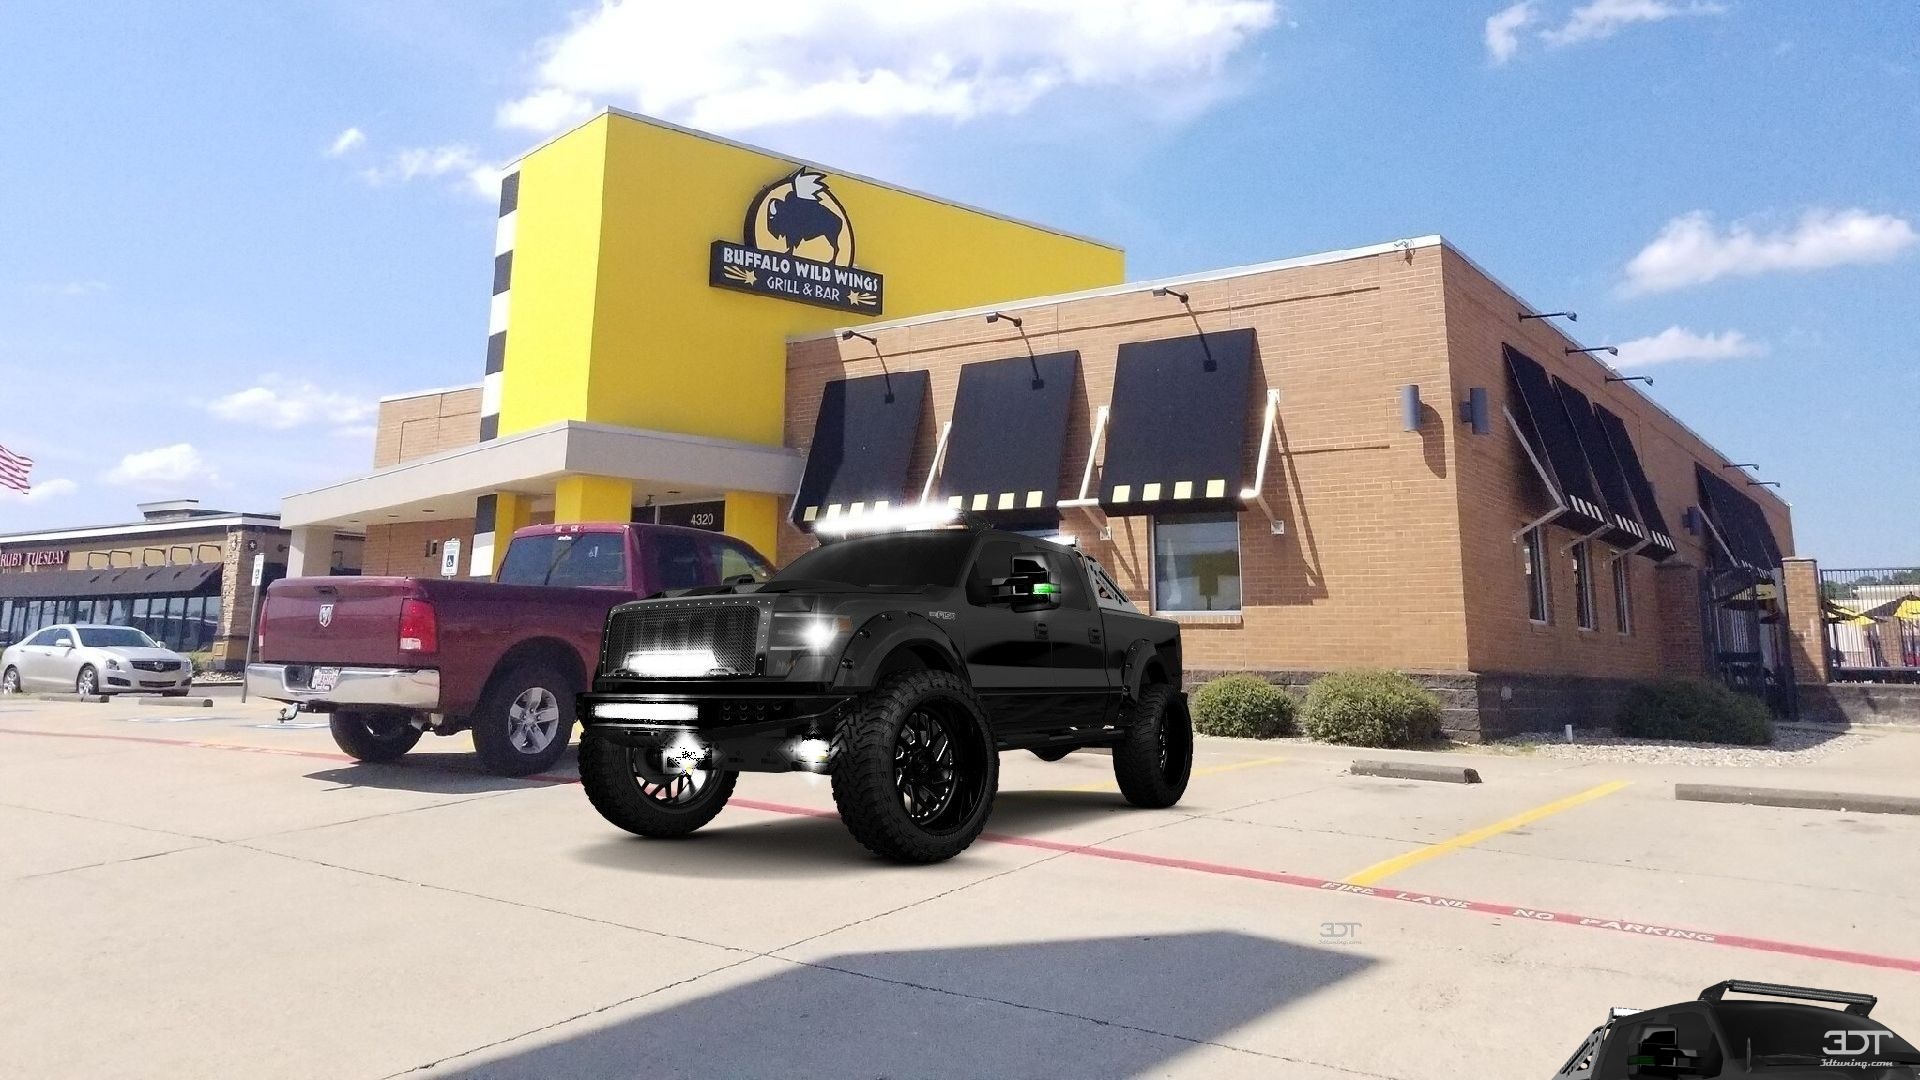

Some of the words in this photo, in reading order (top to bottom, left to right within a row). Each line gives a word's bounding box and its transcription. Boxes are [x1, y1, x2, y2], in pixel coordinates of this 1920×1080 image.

[723, 247, 790, 274] BUFFALO
[795, 261, 831, 282] WILD
[835, 269, 878, 292] WINGS
[767, 276, 800, 295] GRILL
[802, 283, 813, 297] &
[815, 285, 840, 301] BAR
[691, 513, 714, 526] 4320
[0, 553, 22, 567] RUBY
[26, 550, 66, 566] TUESDAY
[1320, 882, 1376, 896] FIRE
[1395, 892, 1472, 908] LANE
[1512, 908, 1555, 921] NO
[1579, 918, 1716, 943] PARKING
